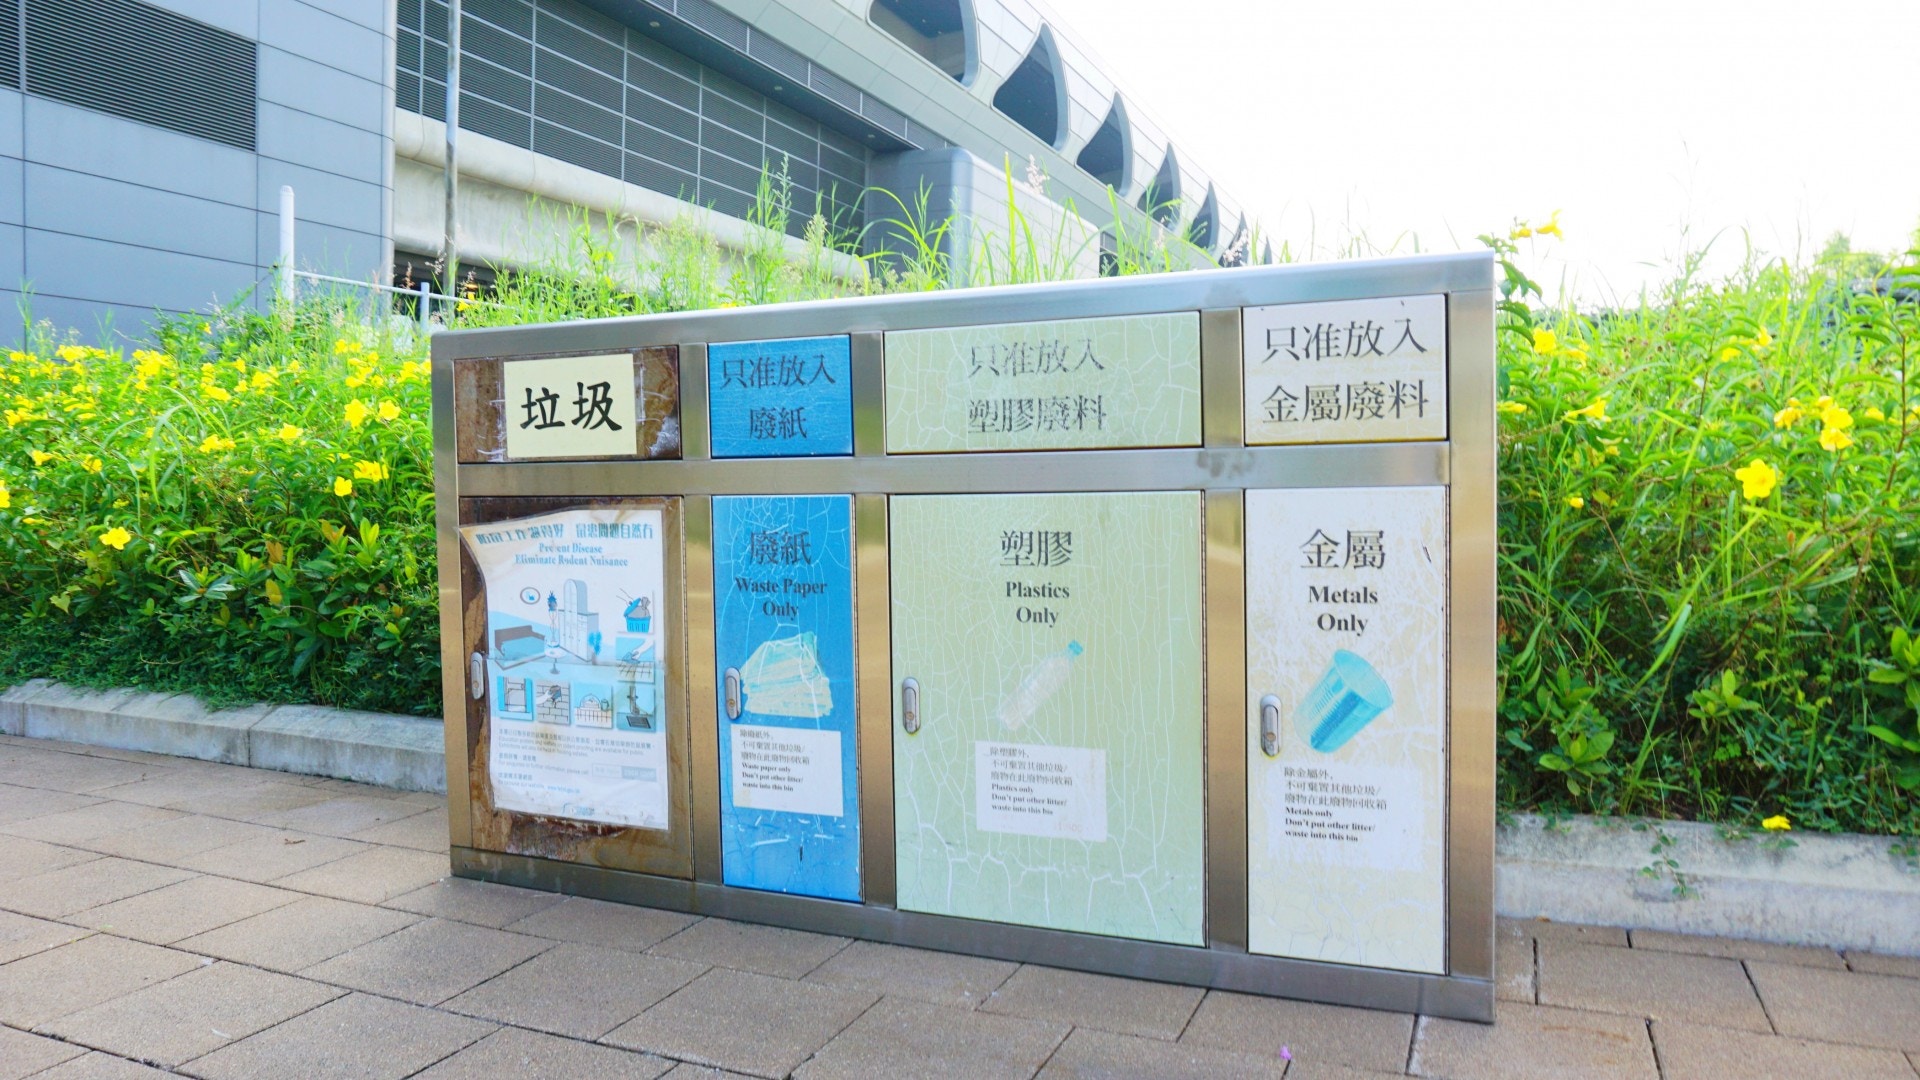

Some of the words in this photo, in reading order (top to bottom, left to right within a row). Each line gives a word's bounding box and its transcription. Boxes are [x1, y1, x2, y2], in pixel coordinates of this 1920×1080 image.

[1261, 318, 1428, 363] 只准放入
[968, 338, 1105, 378] 只准放入
[720, 354, 836, 389] 只准放入
[519, 381, 623, 431] 垃圾
[1261, 379, 1429, 424] 金屬廢料
[749, 406, 807, 440] 廢紙
[967, 395, 1107, 433] 塑膠廢料
[572, 543, 603, 553] Disease
[750, 531, 811, 565] 廢紙
[999, 530, 1073, 567] 塑膠
[1299, 528, 1386, 570] 金屬
[515, 554, 556, 564] Eliminate
[558, 555, 588, 565] Rodent
[590, 555, 628, 566] Nuisance
[735, 577, 779, 593] Waste
[783, 578, 828, 598] Paper
[1006, 581, 1070, 598] Plastics
[1309, 585, 1378, 604] Metals
[762, 600, 799, 621] Only
[1016, 606, 1059, 628] Only
[1317, 612, 1368, 637] Only
[991, 783, 1018, 792] Plastics
[1018, 785, 1034, 794] only
[1013, 795, 1025, 803] put
[1026, 796, 1046, 804] other
[1013, 805, 1026, 813] into
[1028, 806, 1042, 814] this
[1042, 807, 1054, 815] bin
[1285, 806, 1314, 816] Metals
[1315, 809, 1333, 819] only
[1311, 820, 1325, 829] put
[1327, 821, 1349, 830] other
[1285, 830, 1308, 838] waste
[1310, 831, 1327, 839] into
[1329, 832, 1344, 841] this
[1346, 834, 1358, 842] bin
